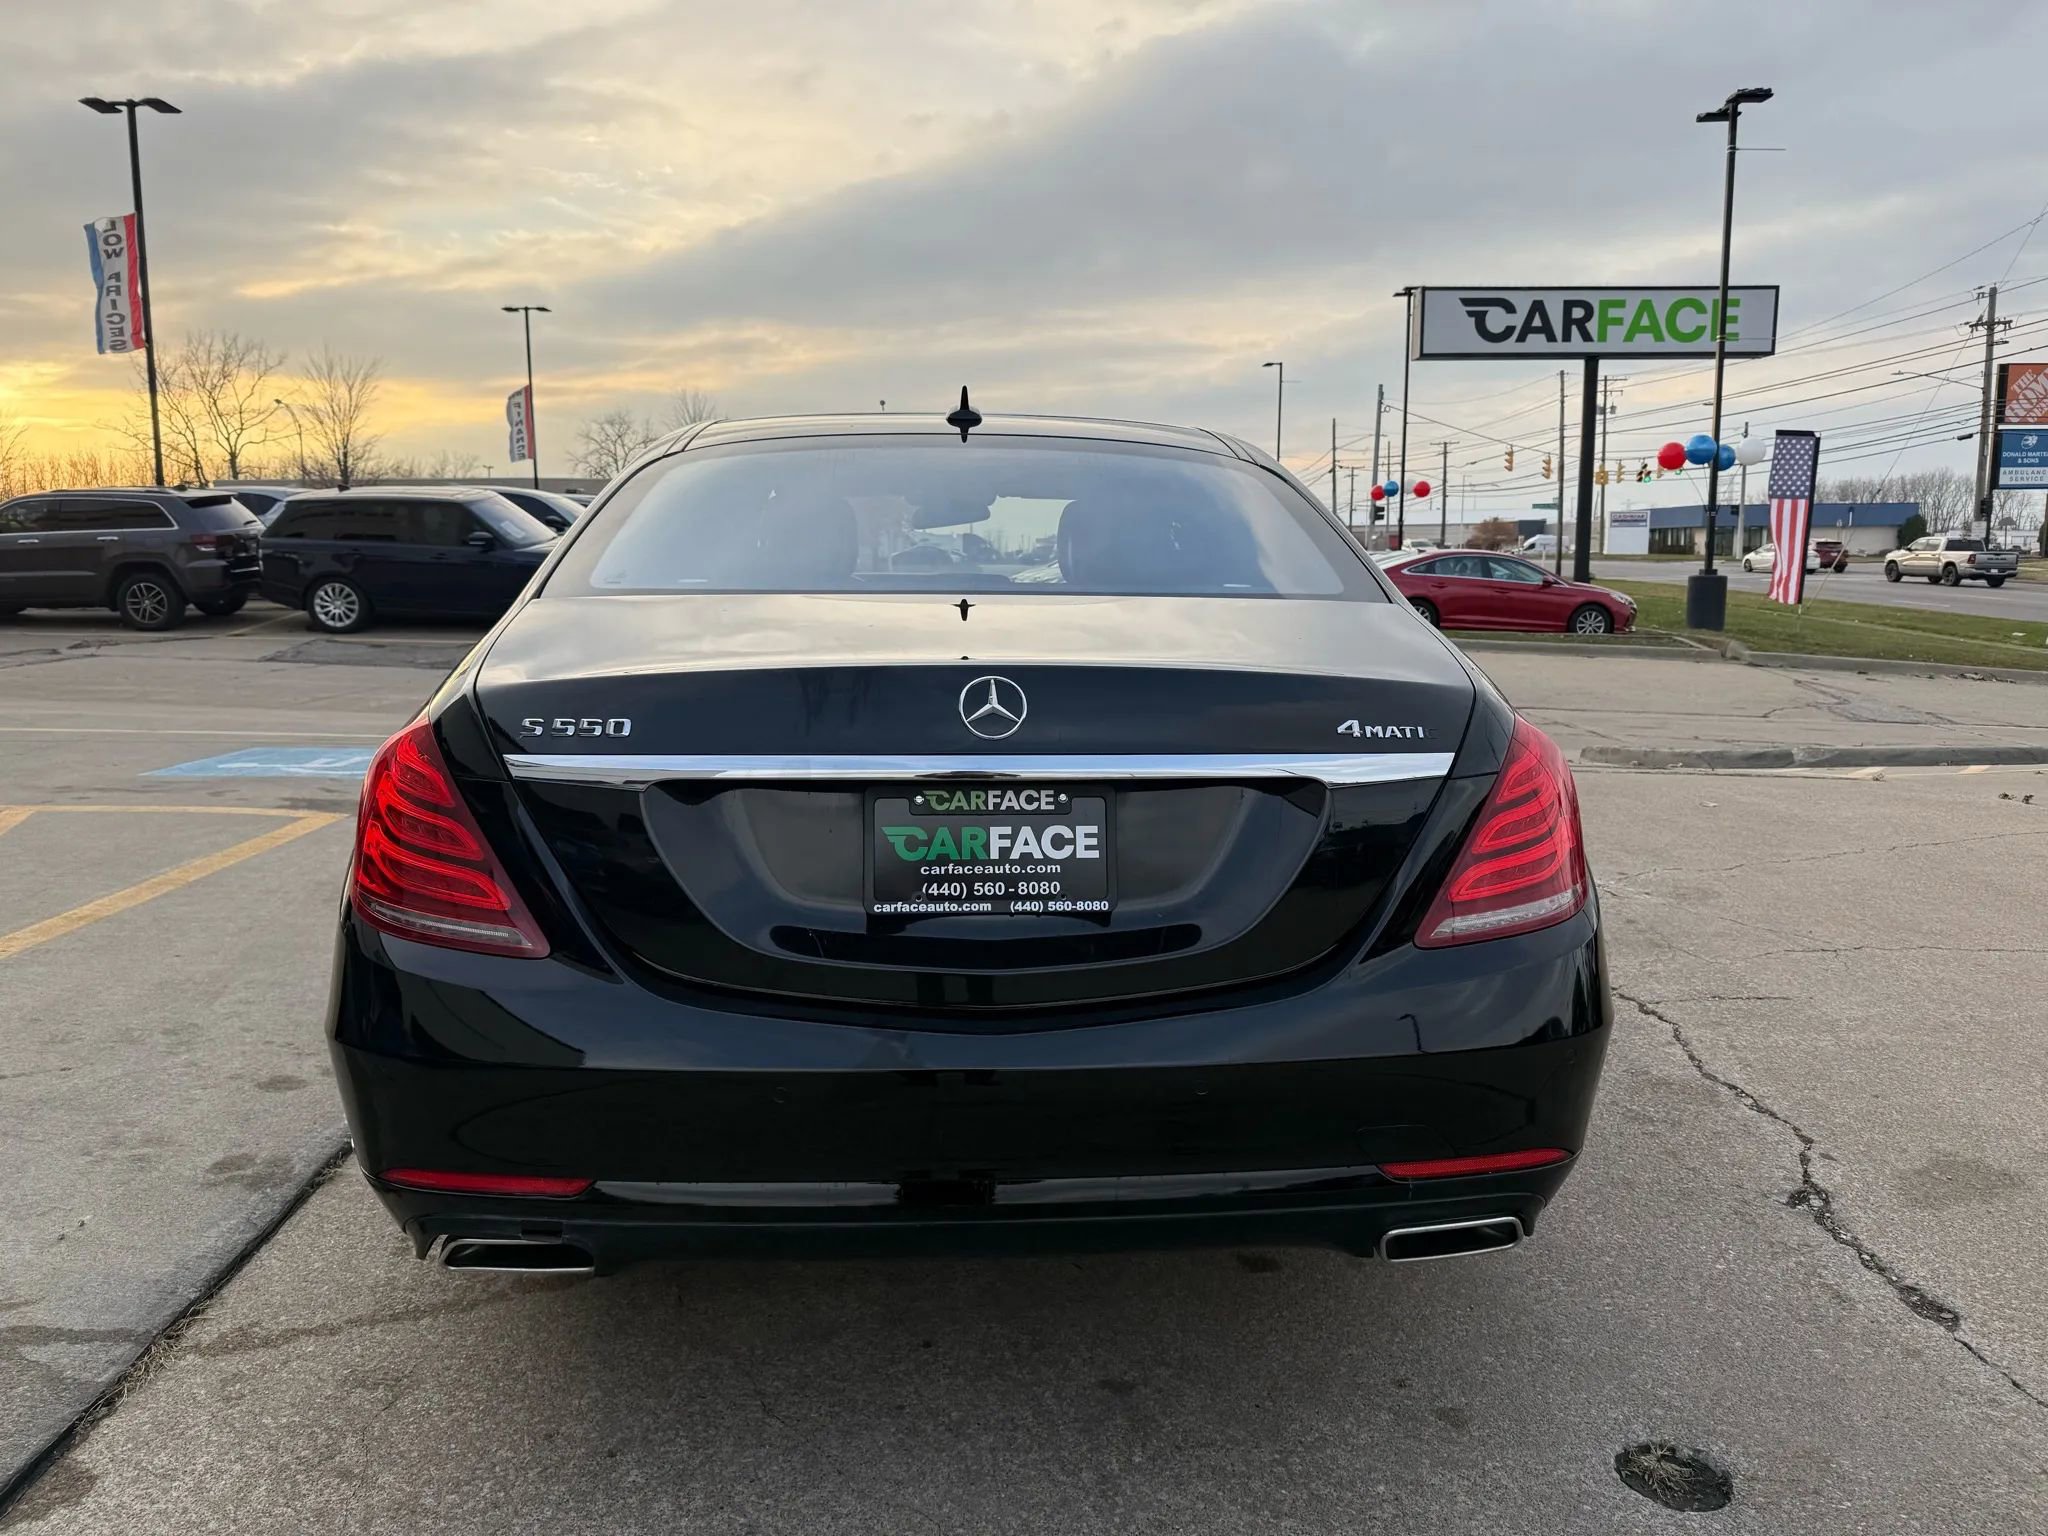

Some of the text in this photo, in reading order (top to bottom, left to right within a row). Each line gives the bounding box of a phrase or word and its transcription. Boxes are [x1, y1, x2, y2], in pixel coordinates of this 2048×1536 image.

[1459, 297, 1741, 343] CARFACE
[2011, 369, 2037, 394] THE
[520, 718, 632, 738] S 550
[923, 789, 1055, 811] CARFACE
[881, 825, 1100, 861] CARFACE
[920, 863, 1061, 875] carfaceauto.com
[922, 882, 967, 899] (440)
[873, 901, 992, 912] carfaceauto.com
[1010, 900, 1109, 913] (440) 560-8080
